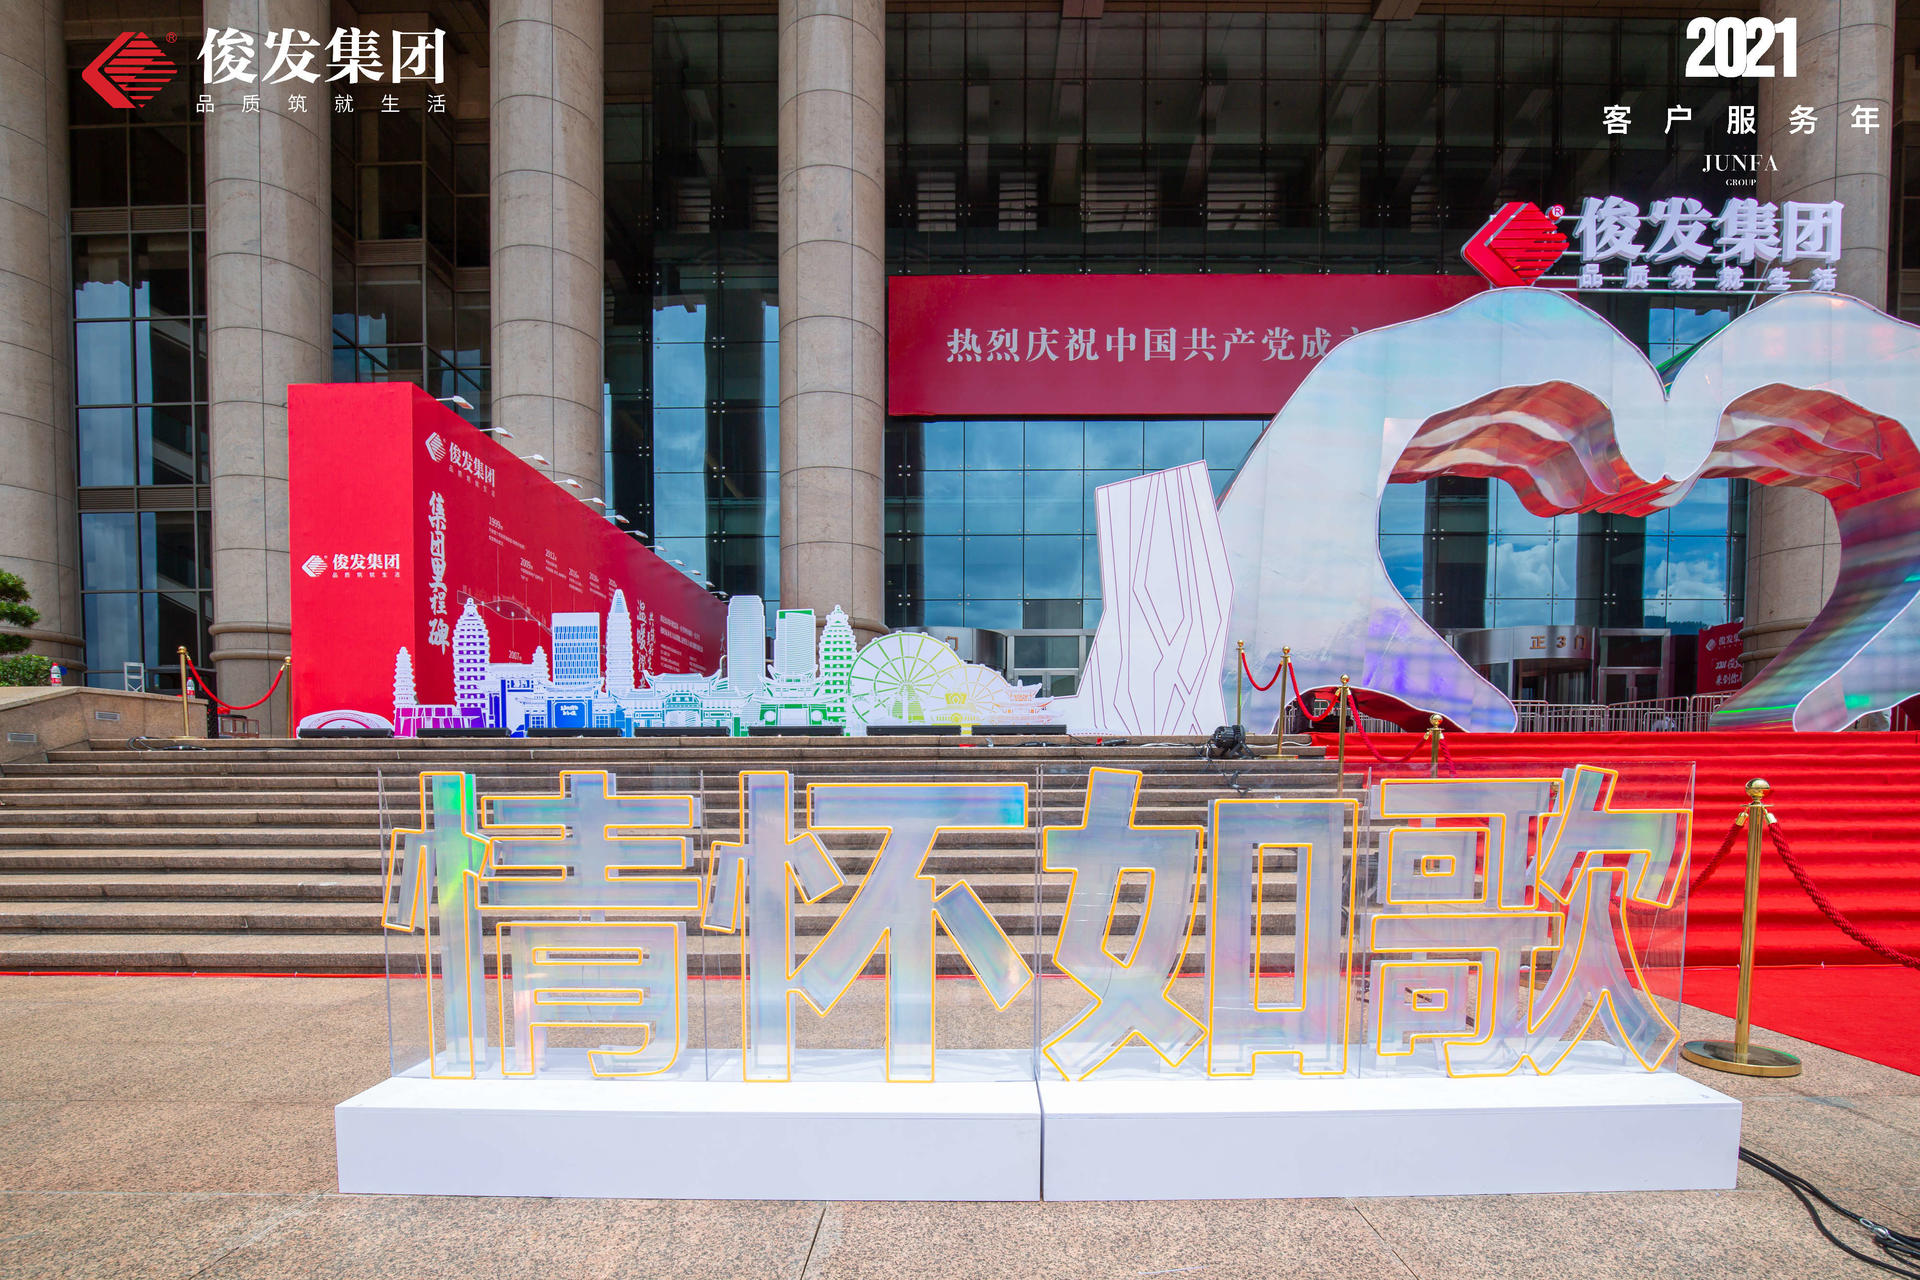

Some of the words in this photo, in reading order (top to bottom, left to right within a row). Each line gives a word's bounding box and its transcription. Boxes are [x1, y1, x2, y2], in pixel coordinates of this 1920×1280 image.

[1573, 196, 1844, 264] 俊发集团
[1578, 263, 1838, 291] 品质筑就生活
[946, 327, 1360, 361] 热烈庆祝中国共产党成
[449, 441, 495, 487] 俊发集团
[332, 553, 400, 570] 俊发集团
[428, 490, 450, 655] 集团里程碑
[381, 765, 1692, 1083] 情怀如歌
